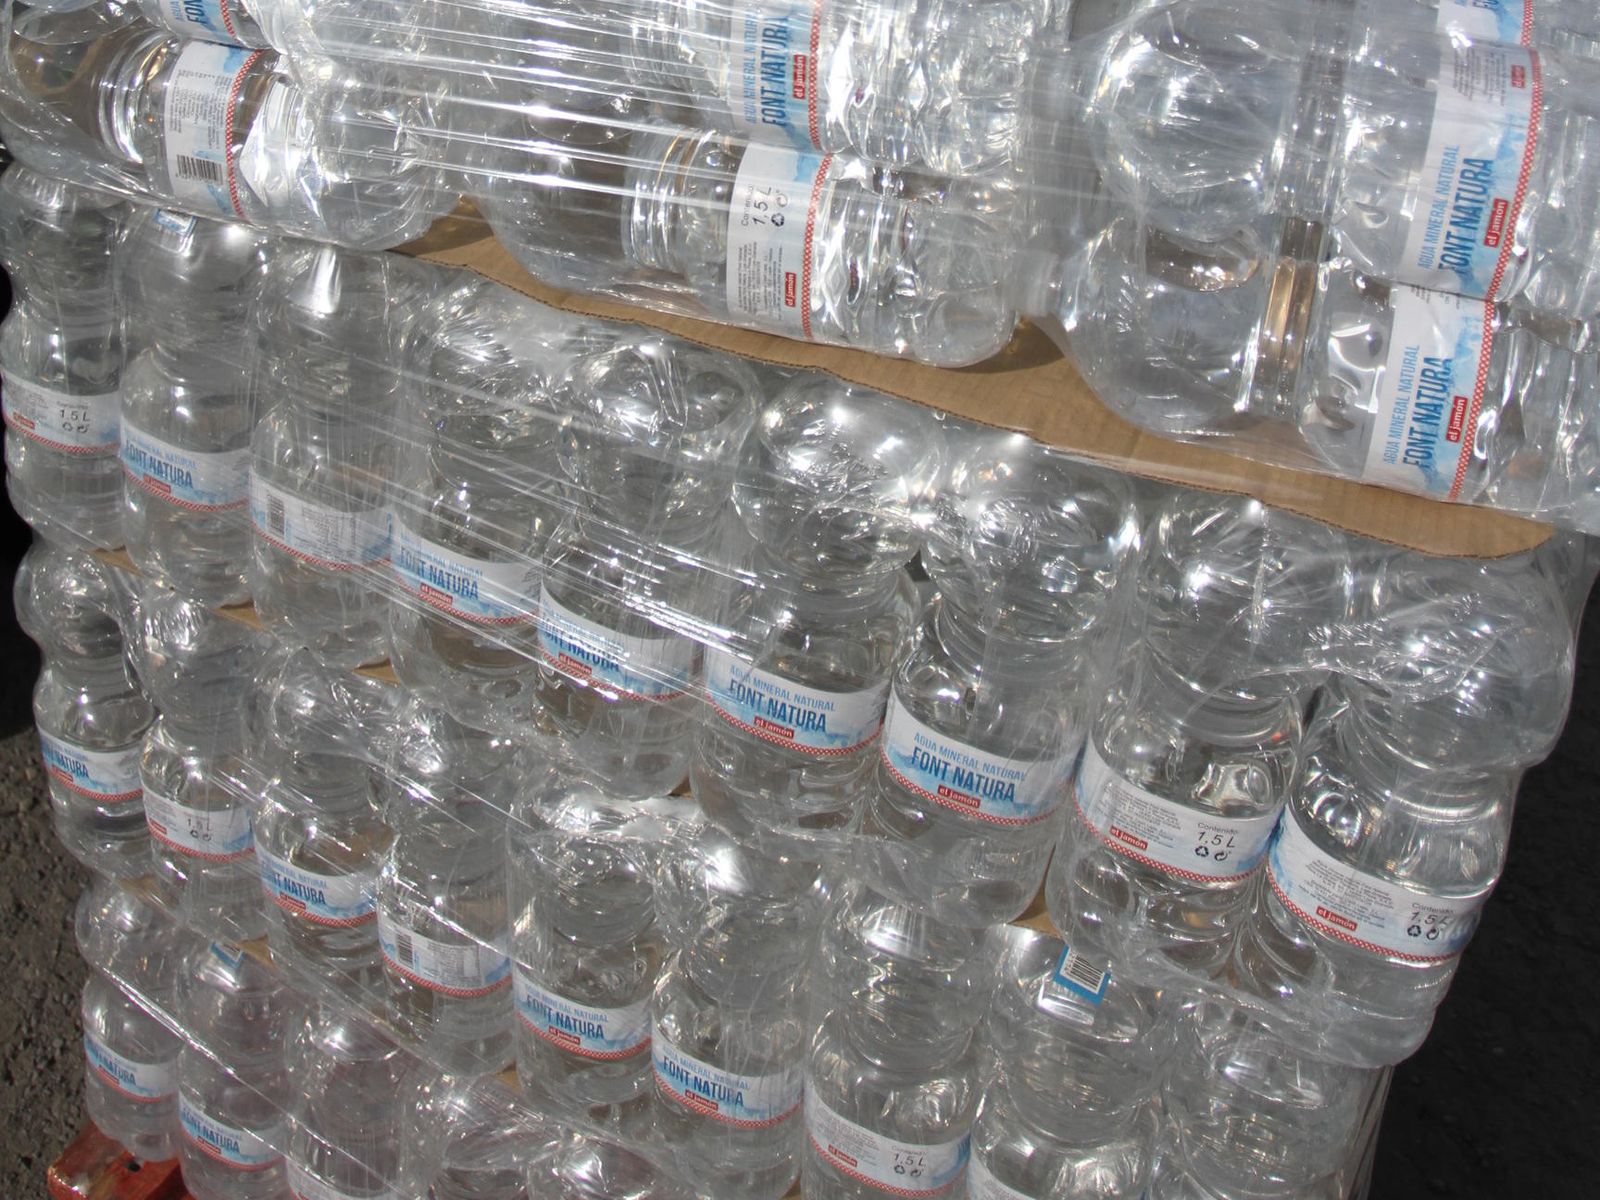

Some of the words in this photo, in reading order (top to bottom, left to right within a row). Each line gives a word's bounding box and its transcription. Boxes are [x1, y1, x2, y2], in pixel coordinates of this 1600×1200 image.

[760, 86, 787, 127] FONT
[1435, 146, 1460, 195] NATURAL
[1450, 158, 1494, 230] NATURA
[1424, 200, 1448, 244] MINERAL
[1486, 235, 1498, 246] el
[1492, 201, 1507, 236] jamón
[1417, 246, 1437, 270] AGUA
[1438, 231, 1476, 274] FONT
[785, 273, 796, 297] jamón
[1398, 345, 1420, 393] NATURAL
[1412, 356, 1454, 428] NATURA
[1389, 398, 1410, 441] MINERAL
[1449, 431, 1459, 442] el
[1453, 399, 1466, 434] jamón
[1383, 439, 1401, 465] AGUA
[1403, 428, 1440, 469] FONT
[149, 456, 194, 489] NATURA
[429, 564, 479, 601] NATURA
[730, 678, 765, 709] FONT
[767, 698, 826, 733] NATURA
[753, 677, 791, 700] MINERAL
[793, 692, 836, 712] NATURAL
[763, 720, 793, 738] jamón
[912, 746, 951, 781] FONT
[952, 766, 1015, 802] NATURA
[914, 732, 937, 751] AGUA
[939, 746, 978, 769] MINERAL
[983, 762, 1026, 781] NATURAL
[949, 789, 979, 808] jamón
[1119, 832, 1147, 850] jamón
[283, 877, 327, 905] NATURA
[1325, 911, 1357, 931] jamón
[526, 994, 553, 1023] FONT
[556, 1012, 606, 1040] NATURA
[663, 1055, 691, 1086] FONT
[694, 1075, 744, 1108] NATURA
[202, 1125, 241, 1154] NATURA
